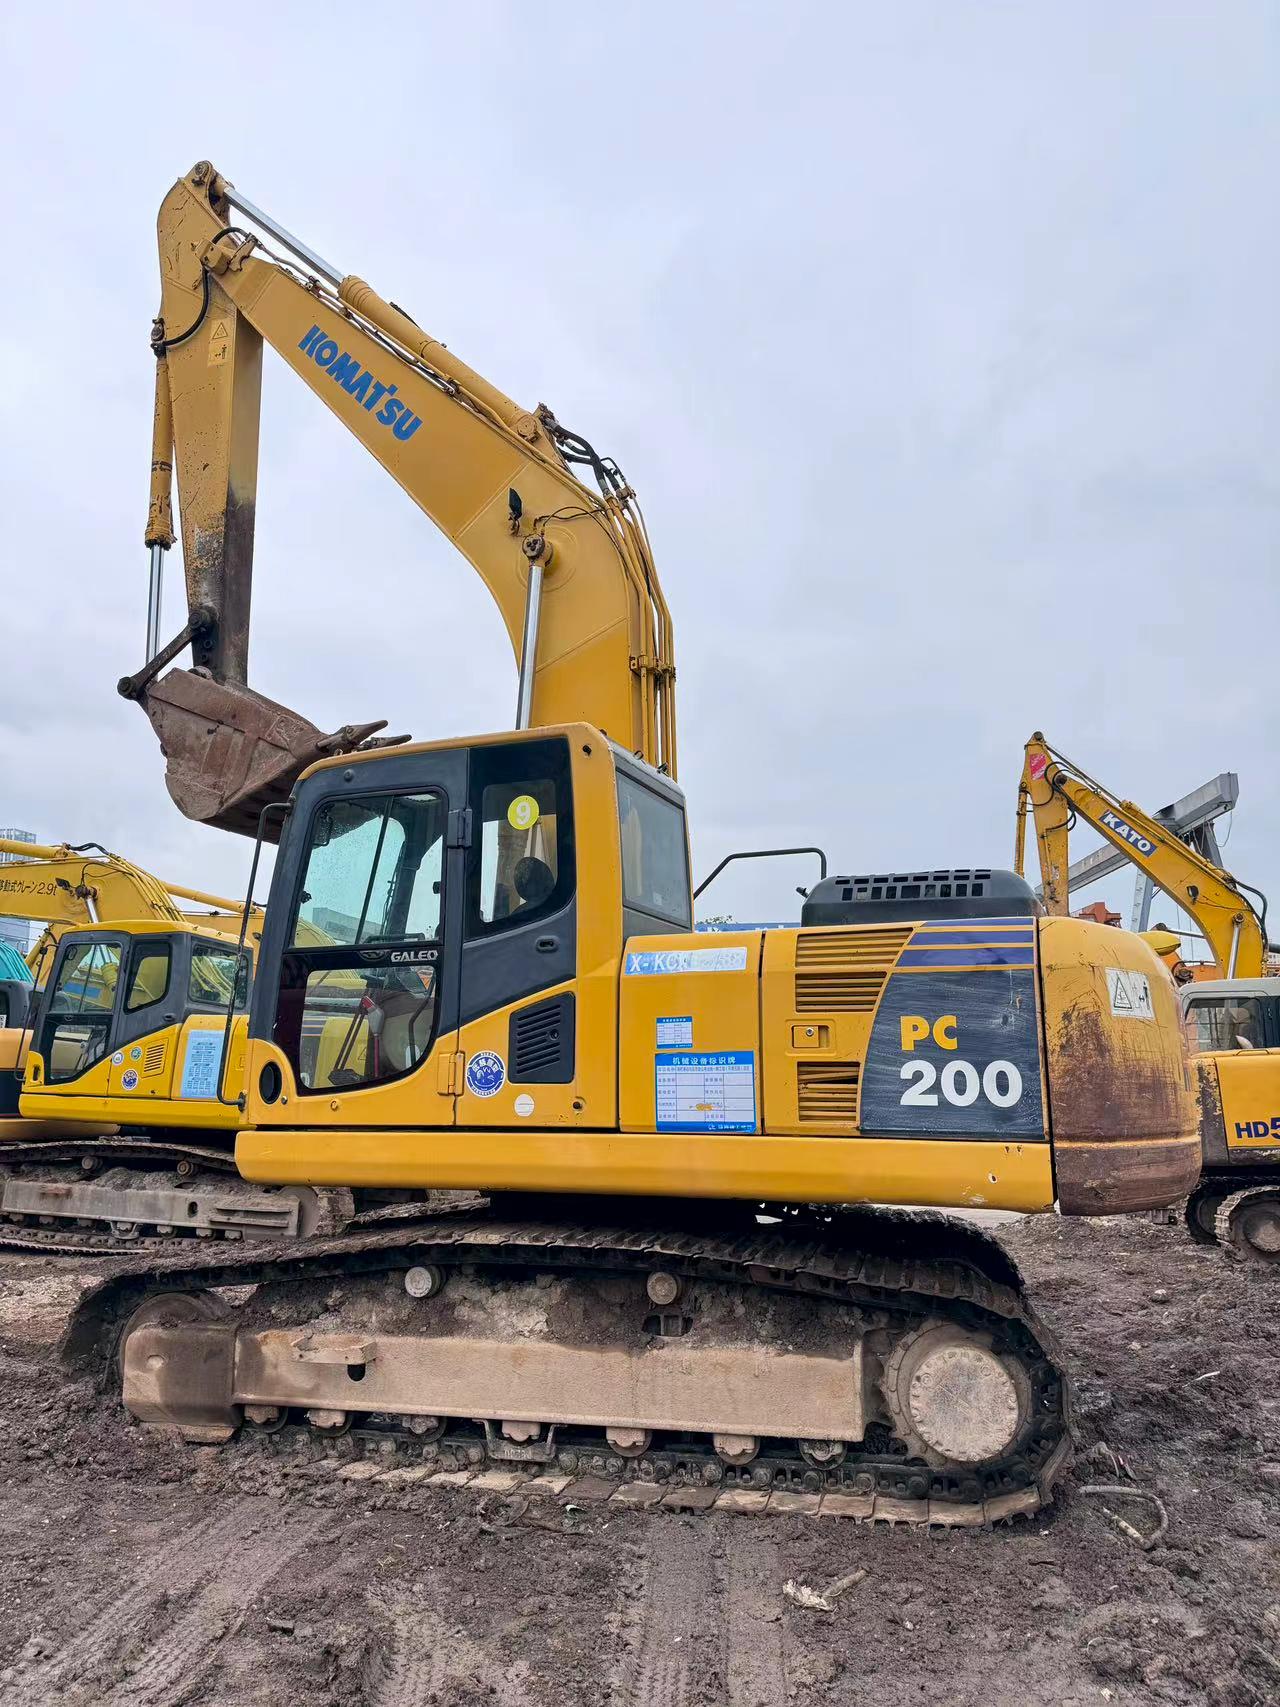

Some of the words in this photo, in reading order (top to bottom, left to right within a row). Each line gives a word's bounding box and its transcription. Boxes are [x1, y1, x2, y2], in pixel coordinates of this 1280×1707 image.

[297, 323, 424, 441] KOMATSU
[516, 801, 531, 826] 9
[1102, 811, 1151, 852] KATO
[391, 949, 439, 963] GALEO
[899, 1014, 958, 1051] PC
[899, 1059, 1023, 1108] 200
